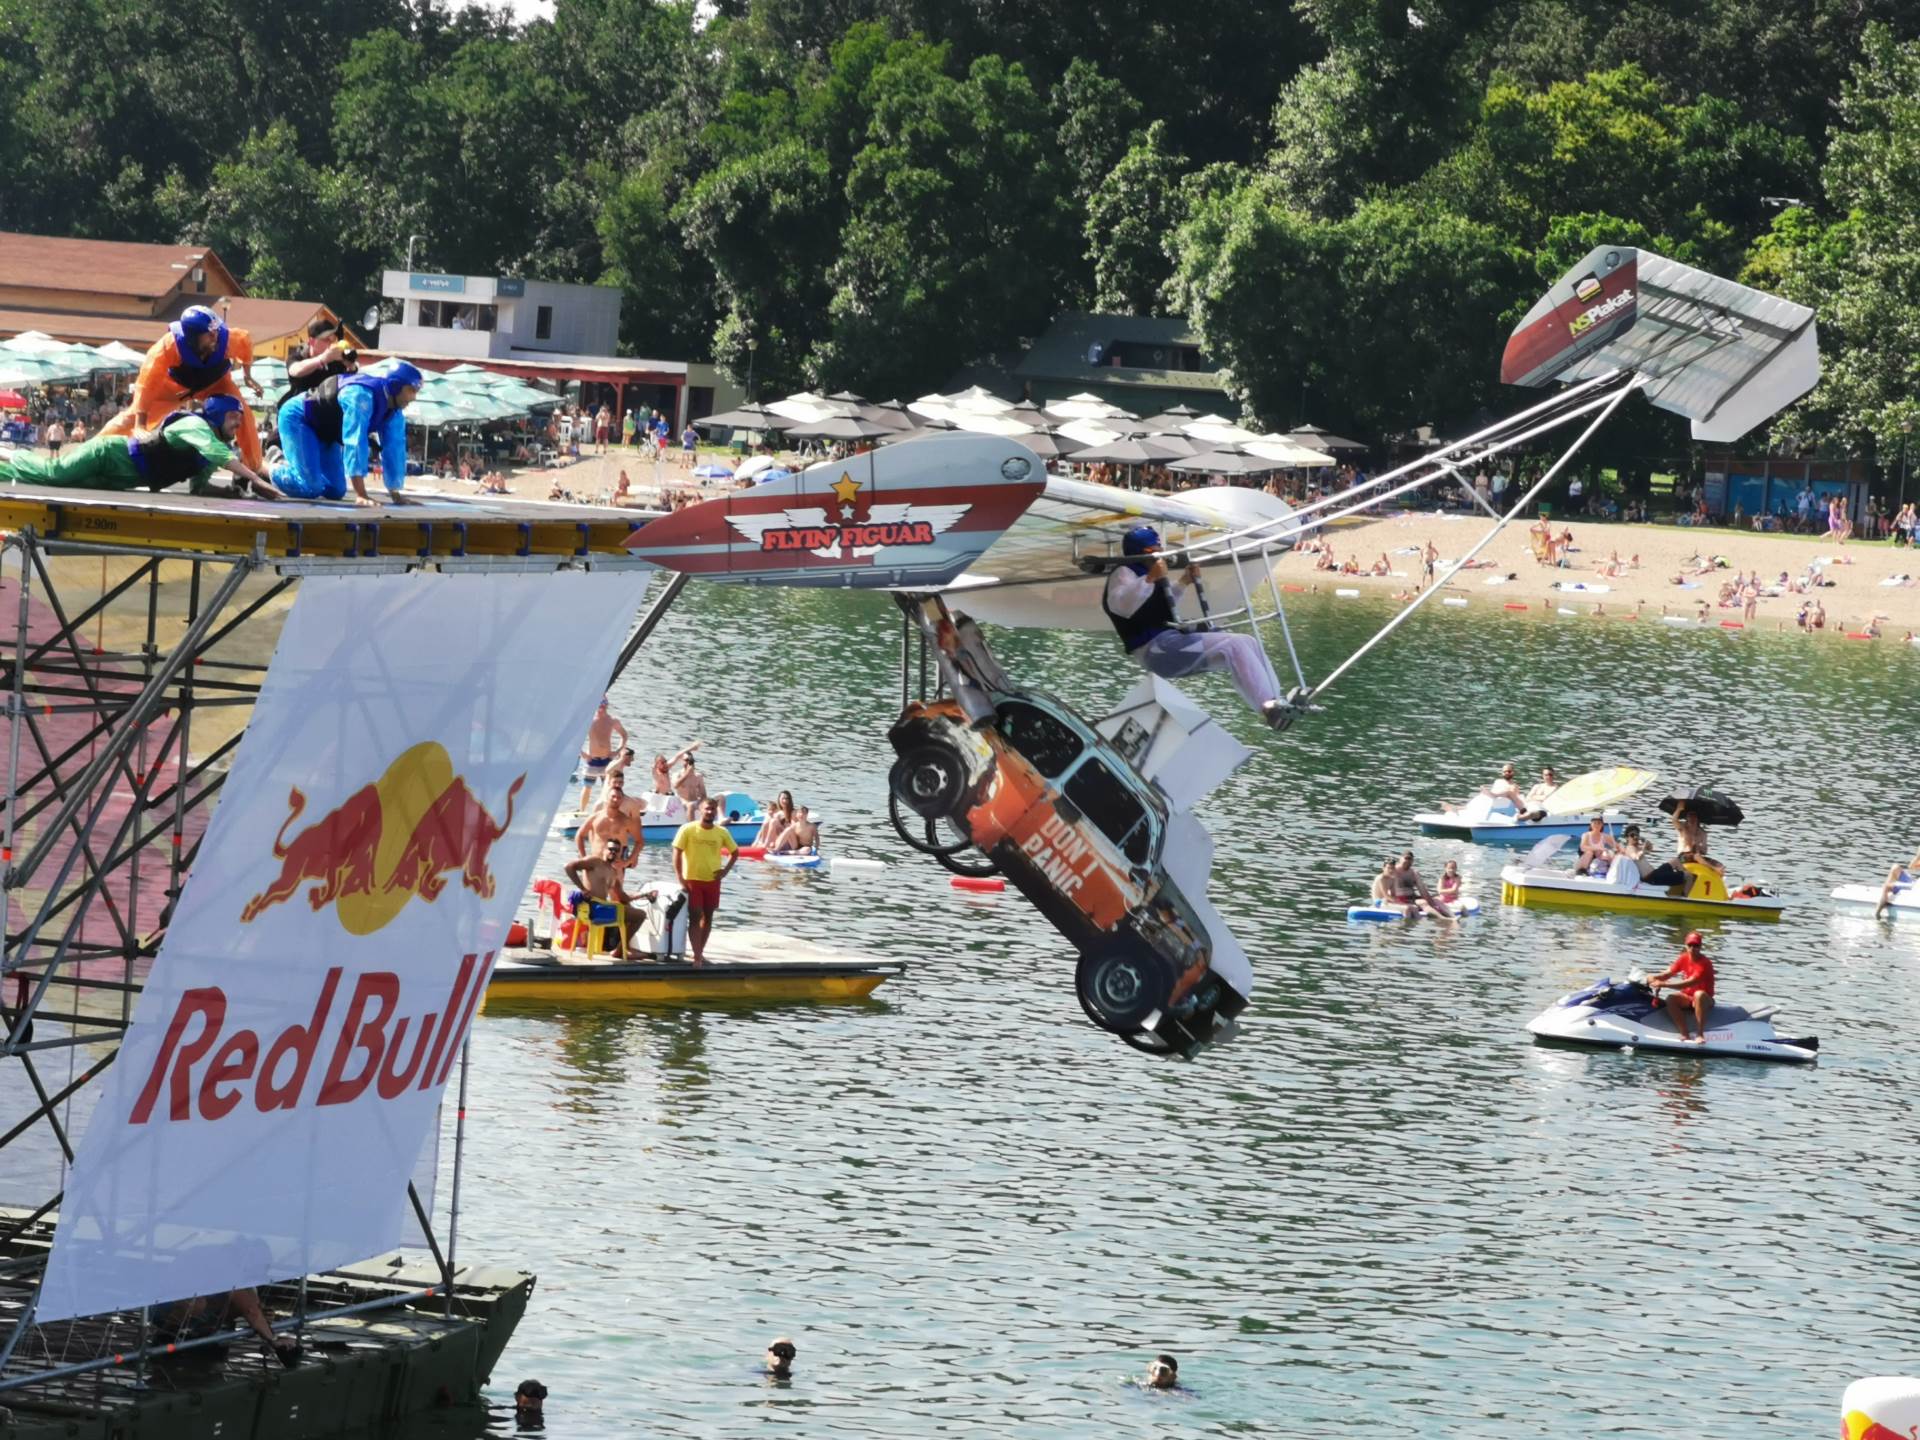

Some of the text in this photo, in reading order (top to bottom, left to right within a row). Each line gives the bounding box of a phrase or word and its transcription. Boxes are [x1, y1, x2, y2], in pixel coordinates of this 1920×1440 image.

[762, 524, 933, 550] FLYIN' FIGUAR
[1703, 880, 1712, 896] 1
[128, 950, 496, 1124] Red Bull
